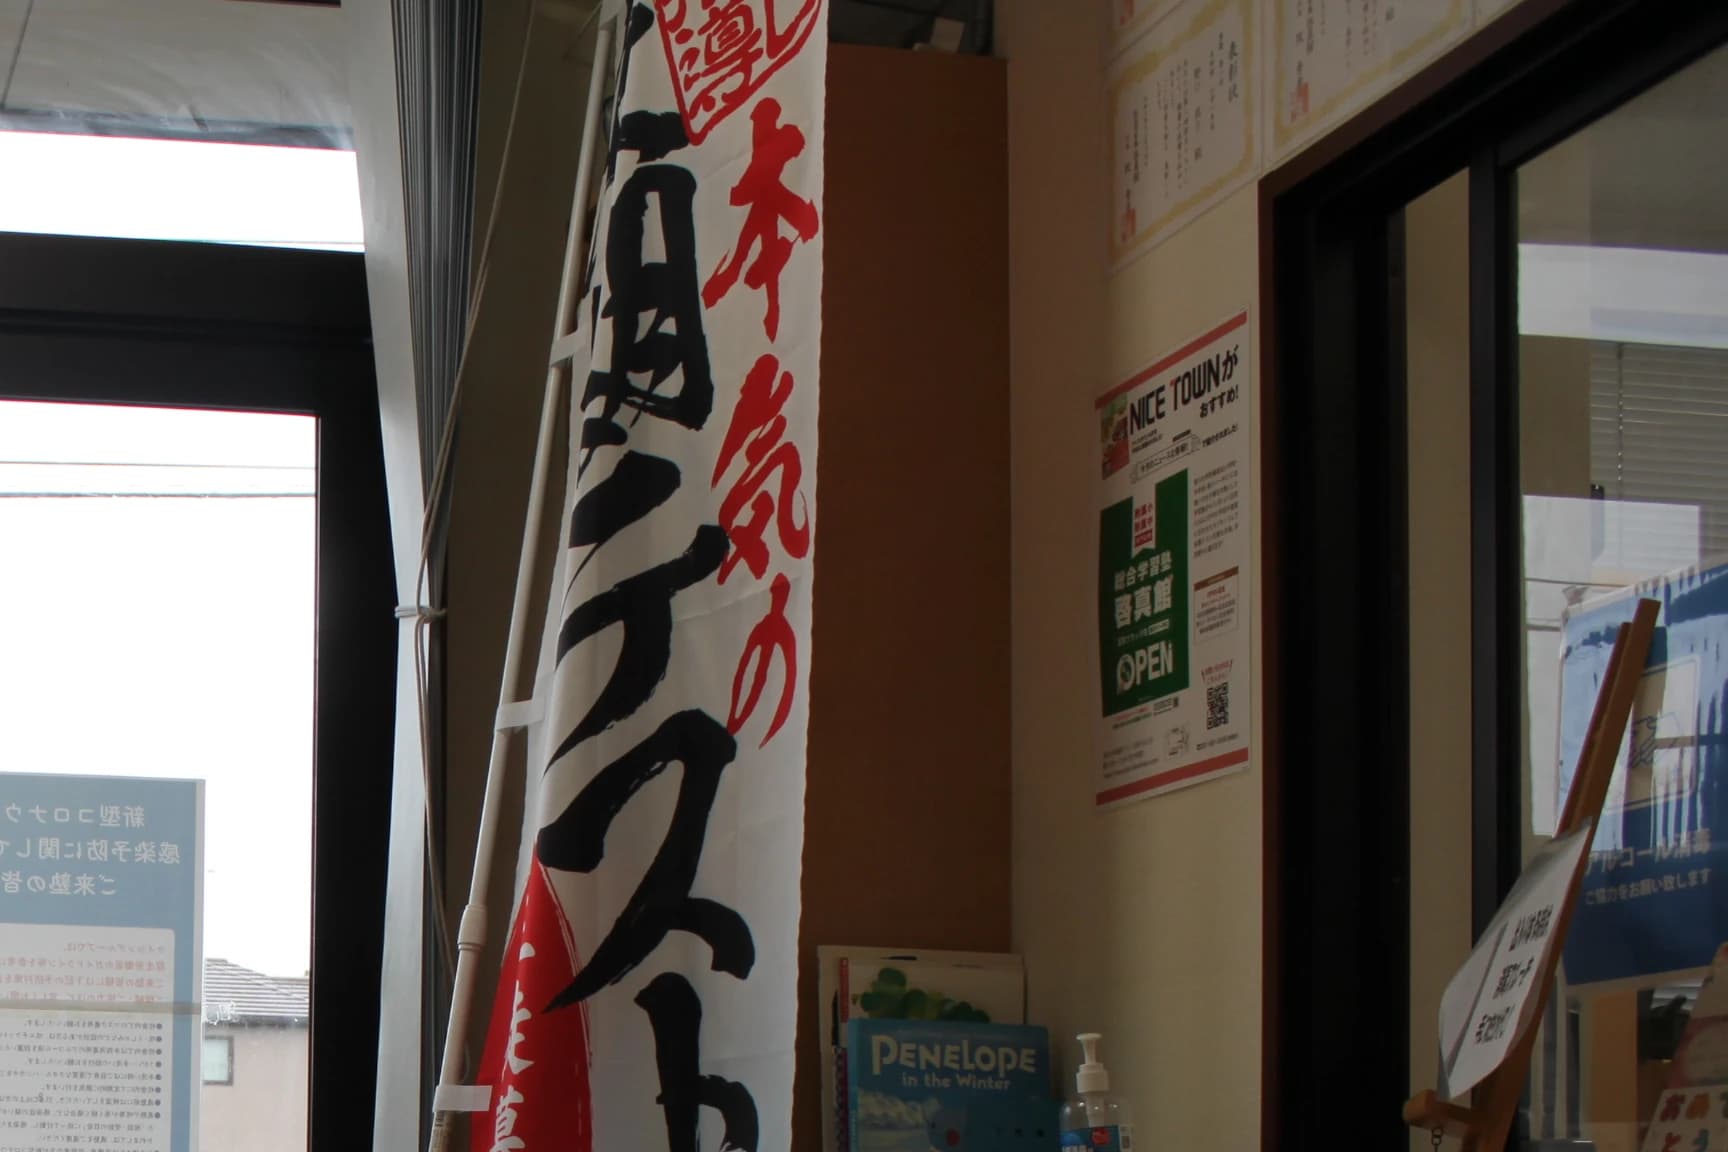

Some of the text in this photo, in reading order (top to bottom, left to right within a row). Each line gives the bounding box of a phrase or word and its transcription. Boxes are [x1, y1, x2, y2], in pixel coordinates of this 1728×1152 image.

[701, 97, 819, 750] 本気の
[1129, 384, 1165, 435] NICE
[1116, 640, 1174, 696] OPEN
[871, 1034, 1037, 1075] PENELOPE
[903, 1073, 1011, 1090] in the Winter
